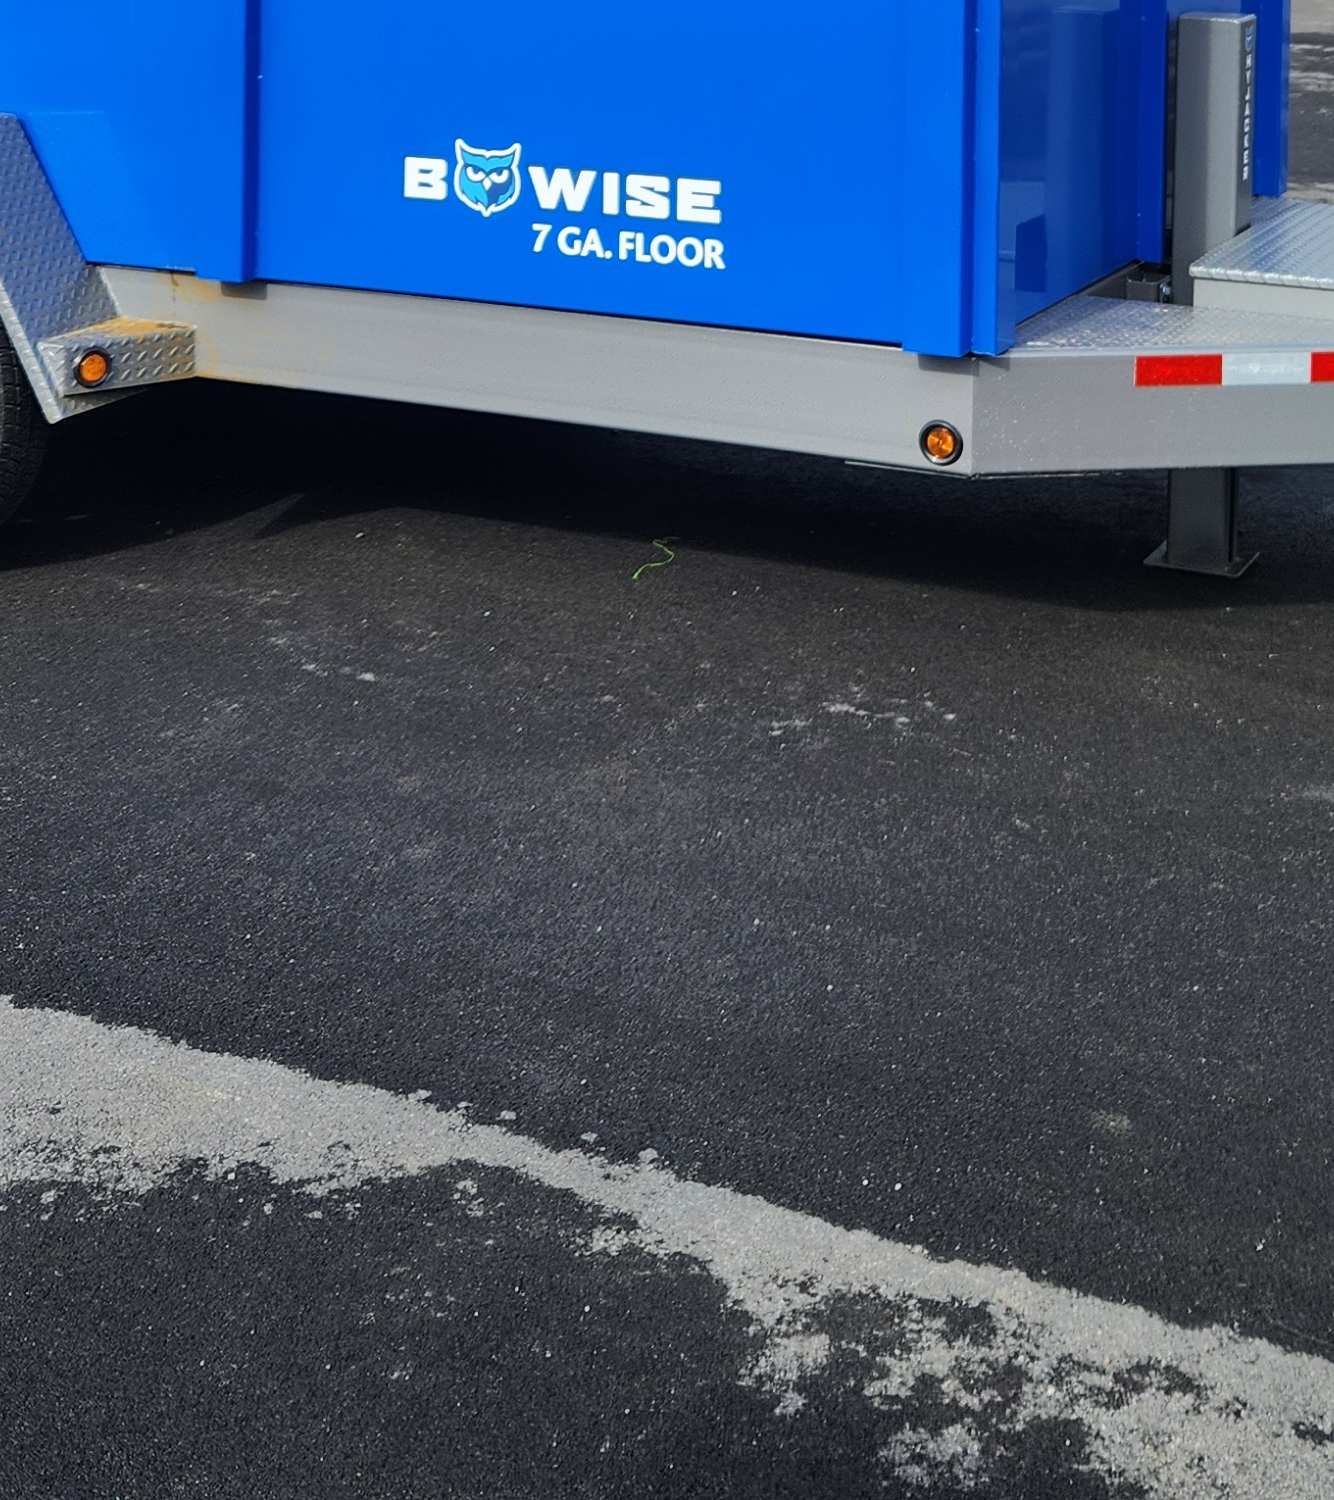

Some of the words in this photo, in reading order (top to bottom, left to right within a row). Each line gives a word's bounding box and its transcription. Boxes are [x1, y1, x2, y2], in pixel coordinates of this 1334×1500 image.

[531, 223, 553, 253] 7
[557, 226, 613, 260] GA.
[618, 230, 727, 270] FLOOR
